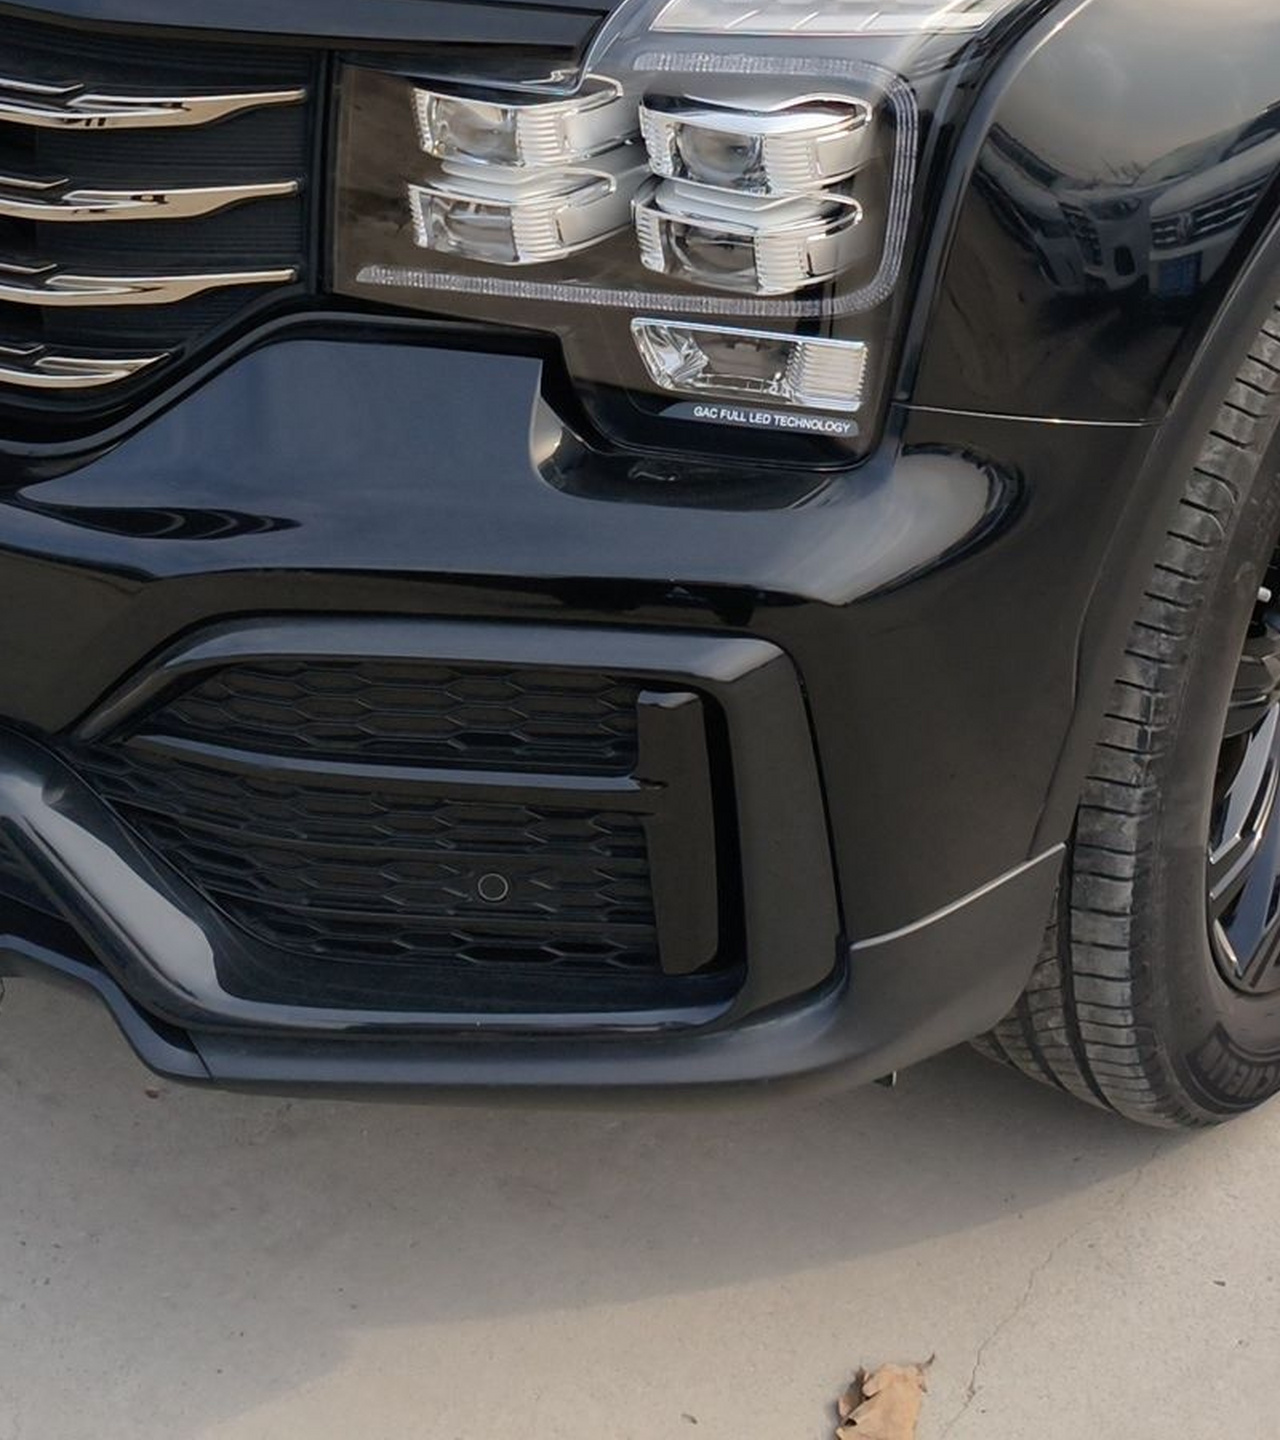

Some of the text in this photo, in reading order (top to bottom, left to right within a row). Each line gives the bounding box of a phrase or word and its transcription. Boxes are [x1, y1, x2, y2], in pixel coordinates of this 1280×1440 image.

[693, 405, 851, 434] GAC FULL LED TECHNOLOGY
